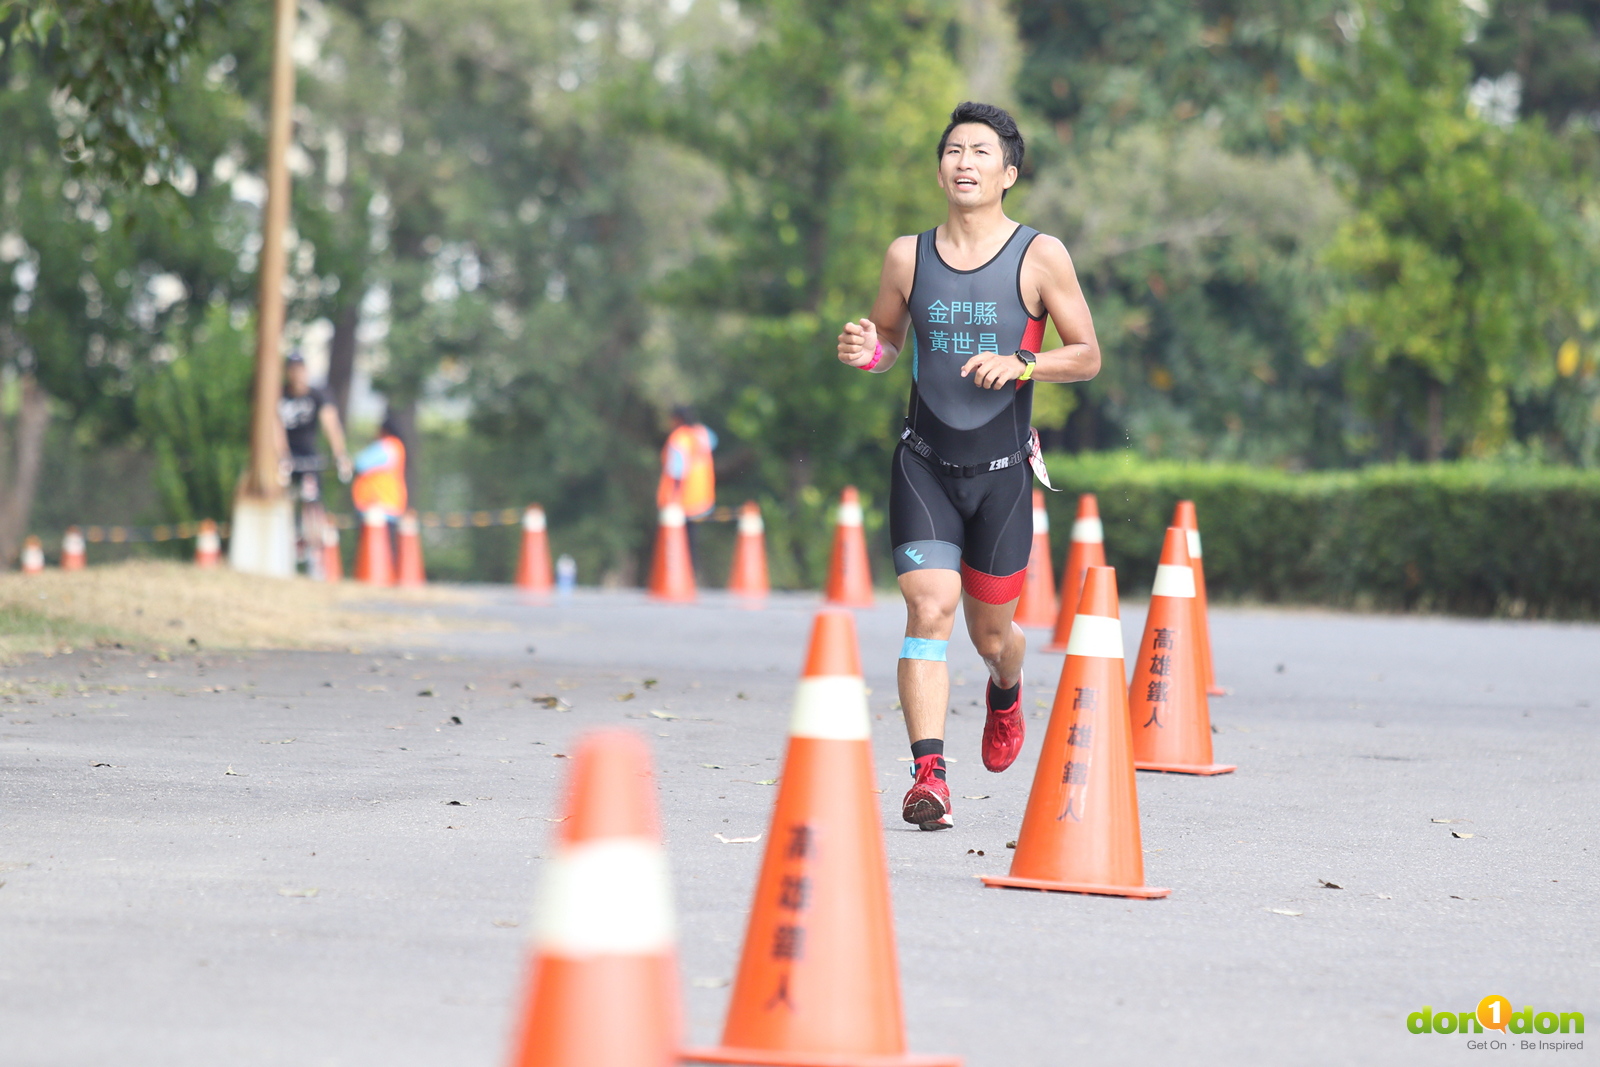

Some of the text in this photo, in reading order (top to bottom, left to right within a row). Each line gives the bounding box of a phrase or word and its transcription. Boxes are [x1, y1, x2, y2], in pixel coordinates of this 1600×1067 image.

[927, 299, 998, 326] 金門縣
[928, 330, 999, 355] 黃世昌
[1142, 627, 1176, 729] 高雄鐵人
[1056, 687, 1099, 822] 高雄鐵人
